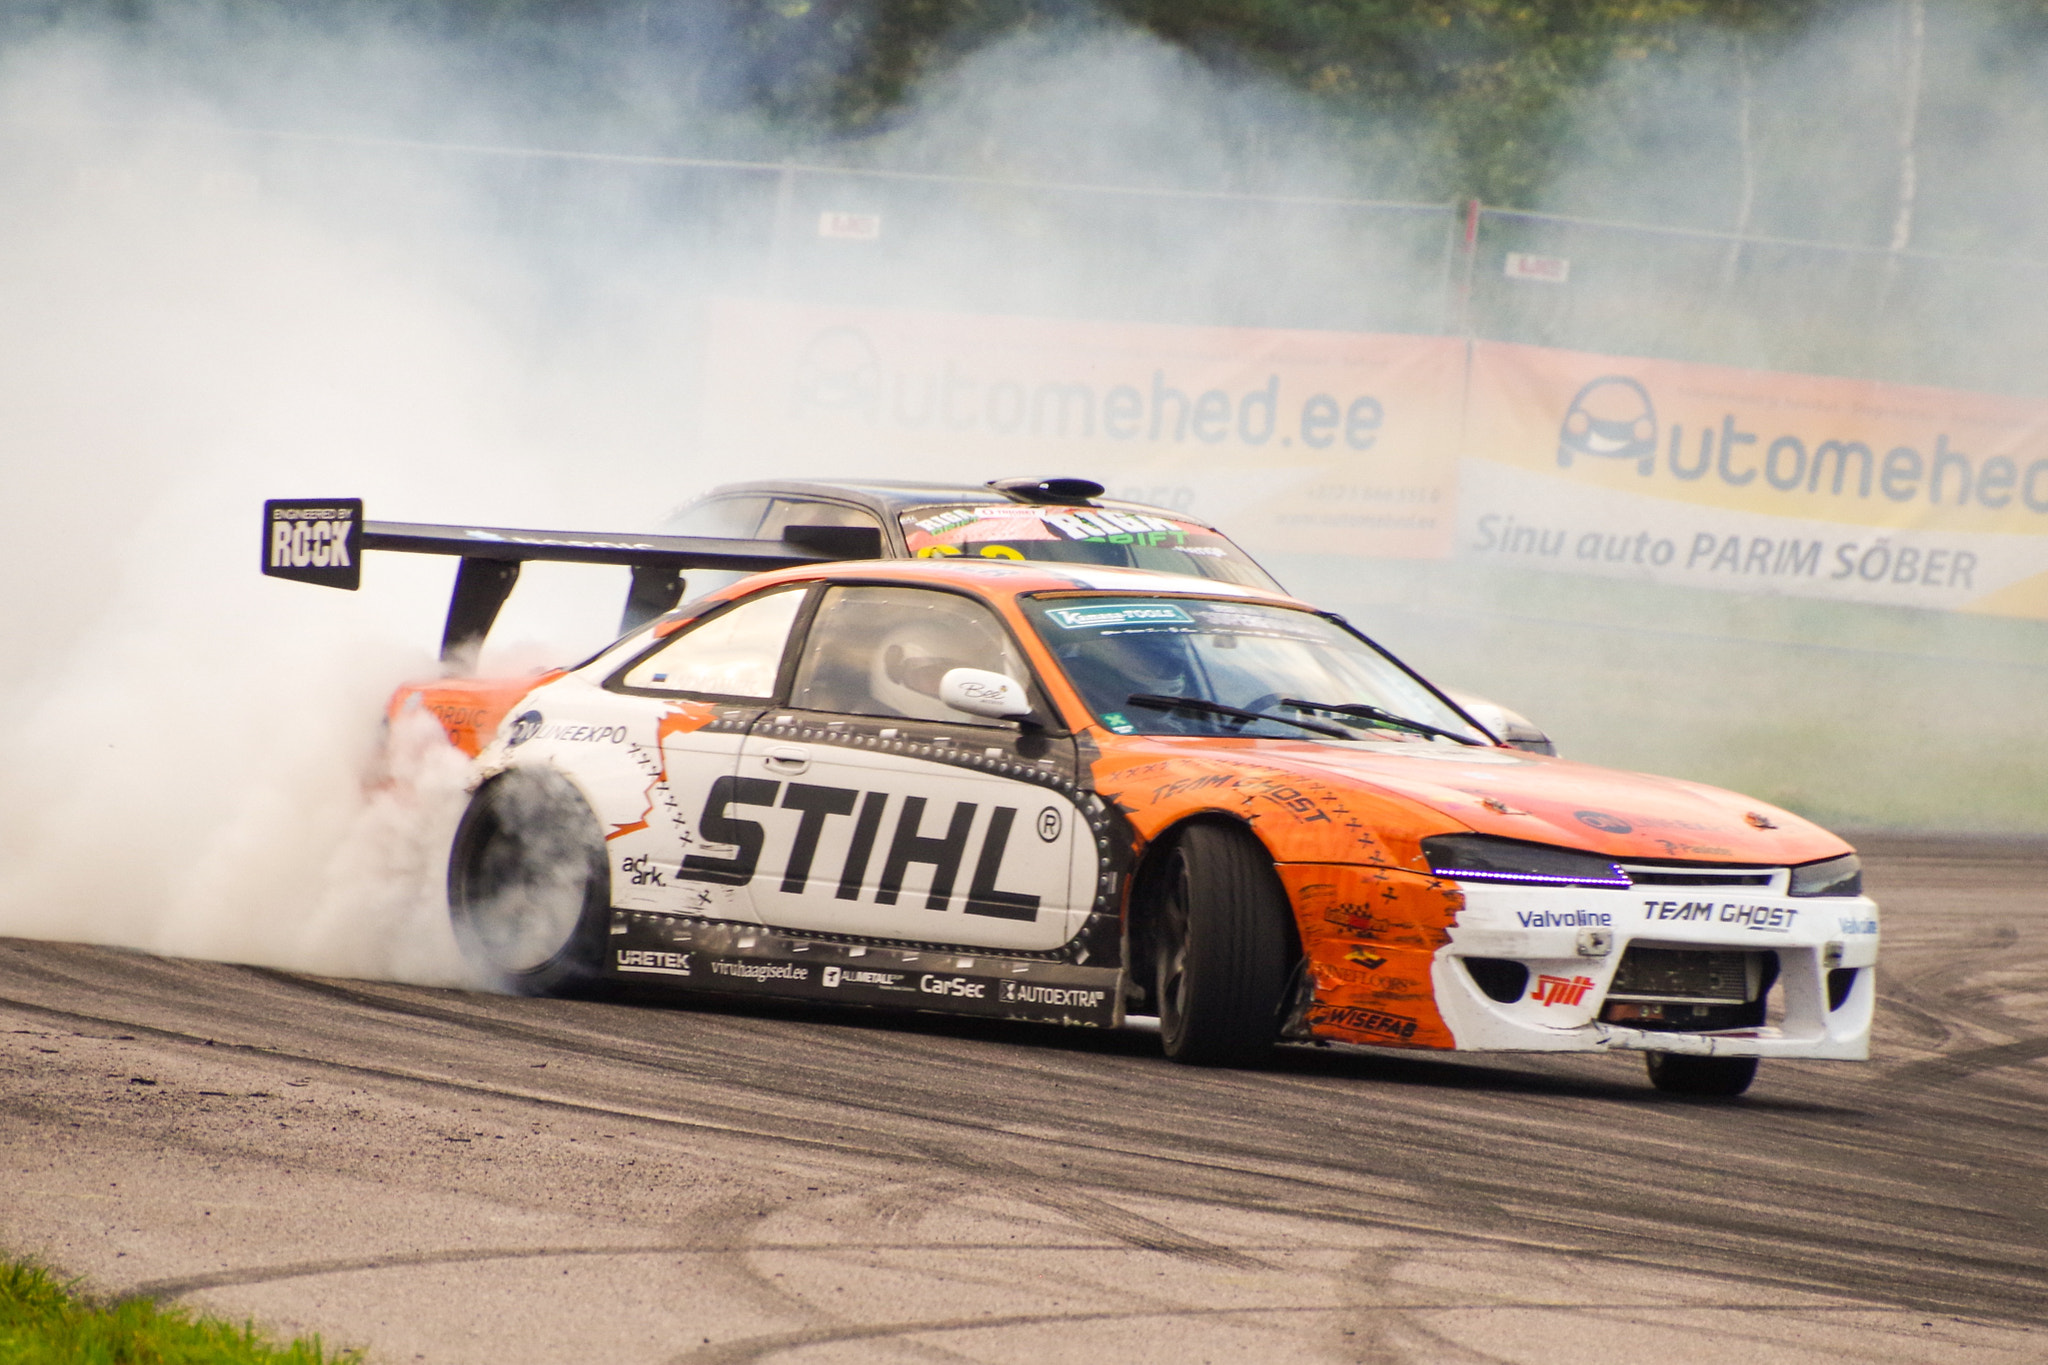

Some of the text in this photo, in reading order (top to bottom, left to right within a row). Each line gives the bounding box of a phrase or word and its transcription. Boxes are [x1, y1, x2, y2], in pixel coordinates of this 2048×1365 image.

[915, 509, 977, 533] RIGA
[1045, 509, 1183, 541] RIGA
[270, 520, 353, 567] ROCK
[1473, 512, 1567, 557] Sinu
[1575, 528, 1676, 568] auto
[1686, 531, 1823, 578] PARIM
[1831, 538, 1978, 590] SÕBER
[1151, 774, 1332, 824] TEAM GHOST
[675, 775, 1042, 924] STIHL
[1517, 909, 1611, 928] Valvoline
[1644, 901, 1799, 930] TEAM GHOST
[617, 949, 691, 969] URETEK
[711, 958, 809, 983] viruhaagised.ee
[920, 974, 986, 999] CarSec
[1017, 985, 1099, 1008] AUTOEXTRA
[1328, 1008, 1418, 1038] WISEFAB
